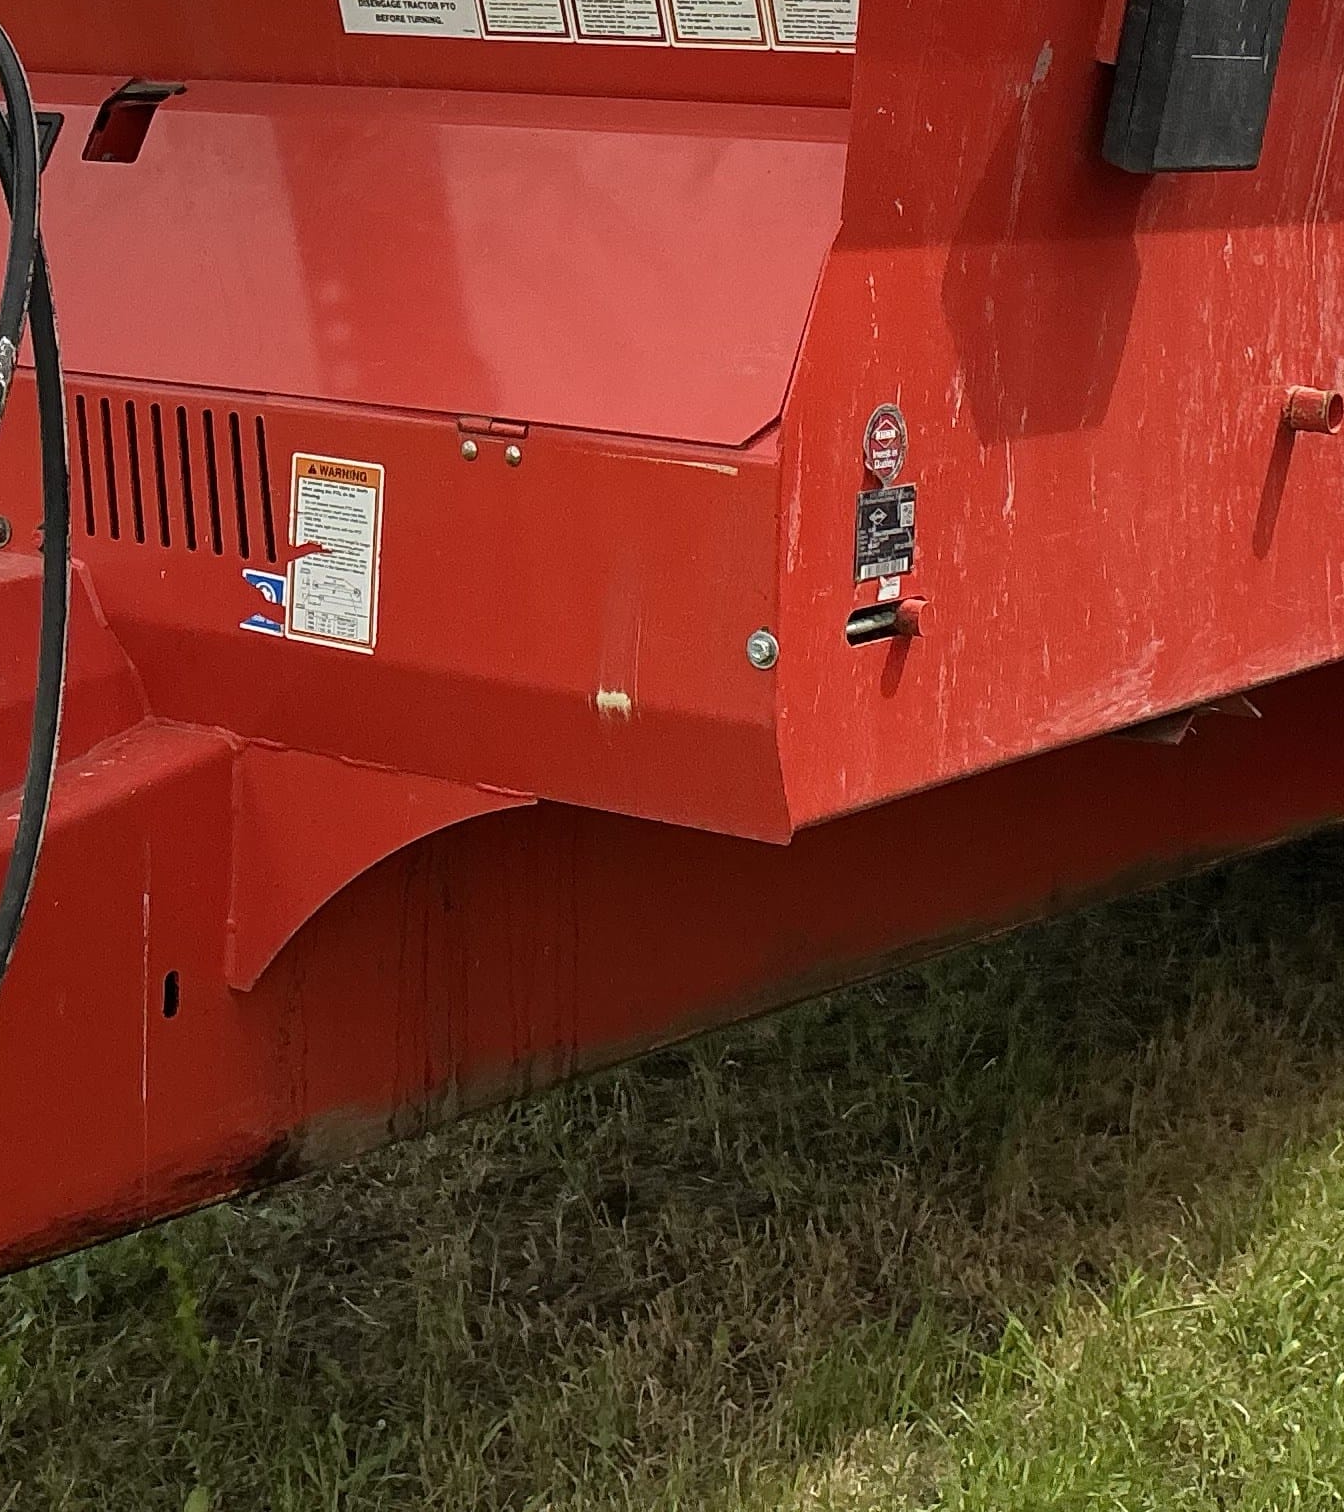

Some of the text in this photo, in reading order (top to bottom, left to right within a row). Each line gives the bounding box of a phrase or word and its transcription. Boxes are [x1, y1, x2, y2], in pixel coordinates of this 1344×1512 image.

[358, 0, 457, 11] DISENGAGE TRACTOR PTO
[375, 14, 406, 23] BEFORE
[319, 464, 368, 483] WARNING
